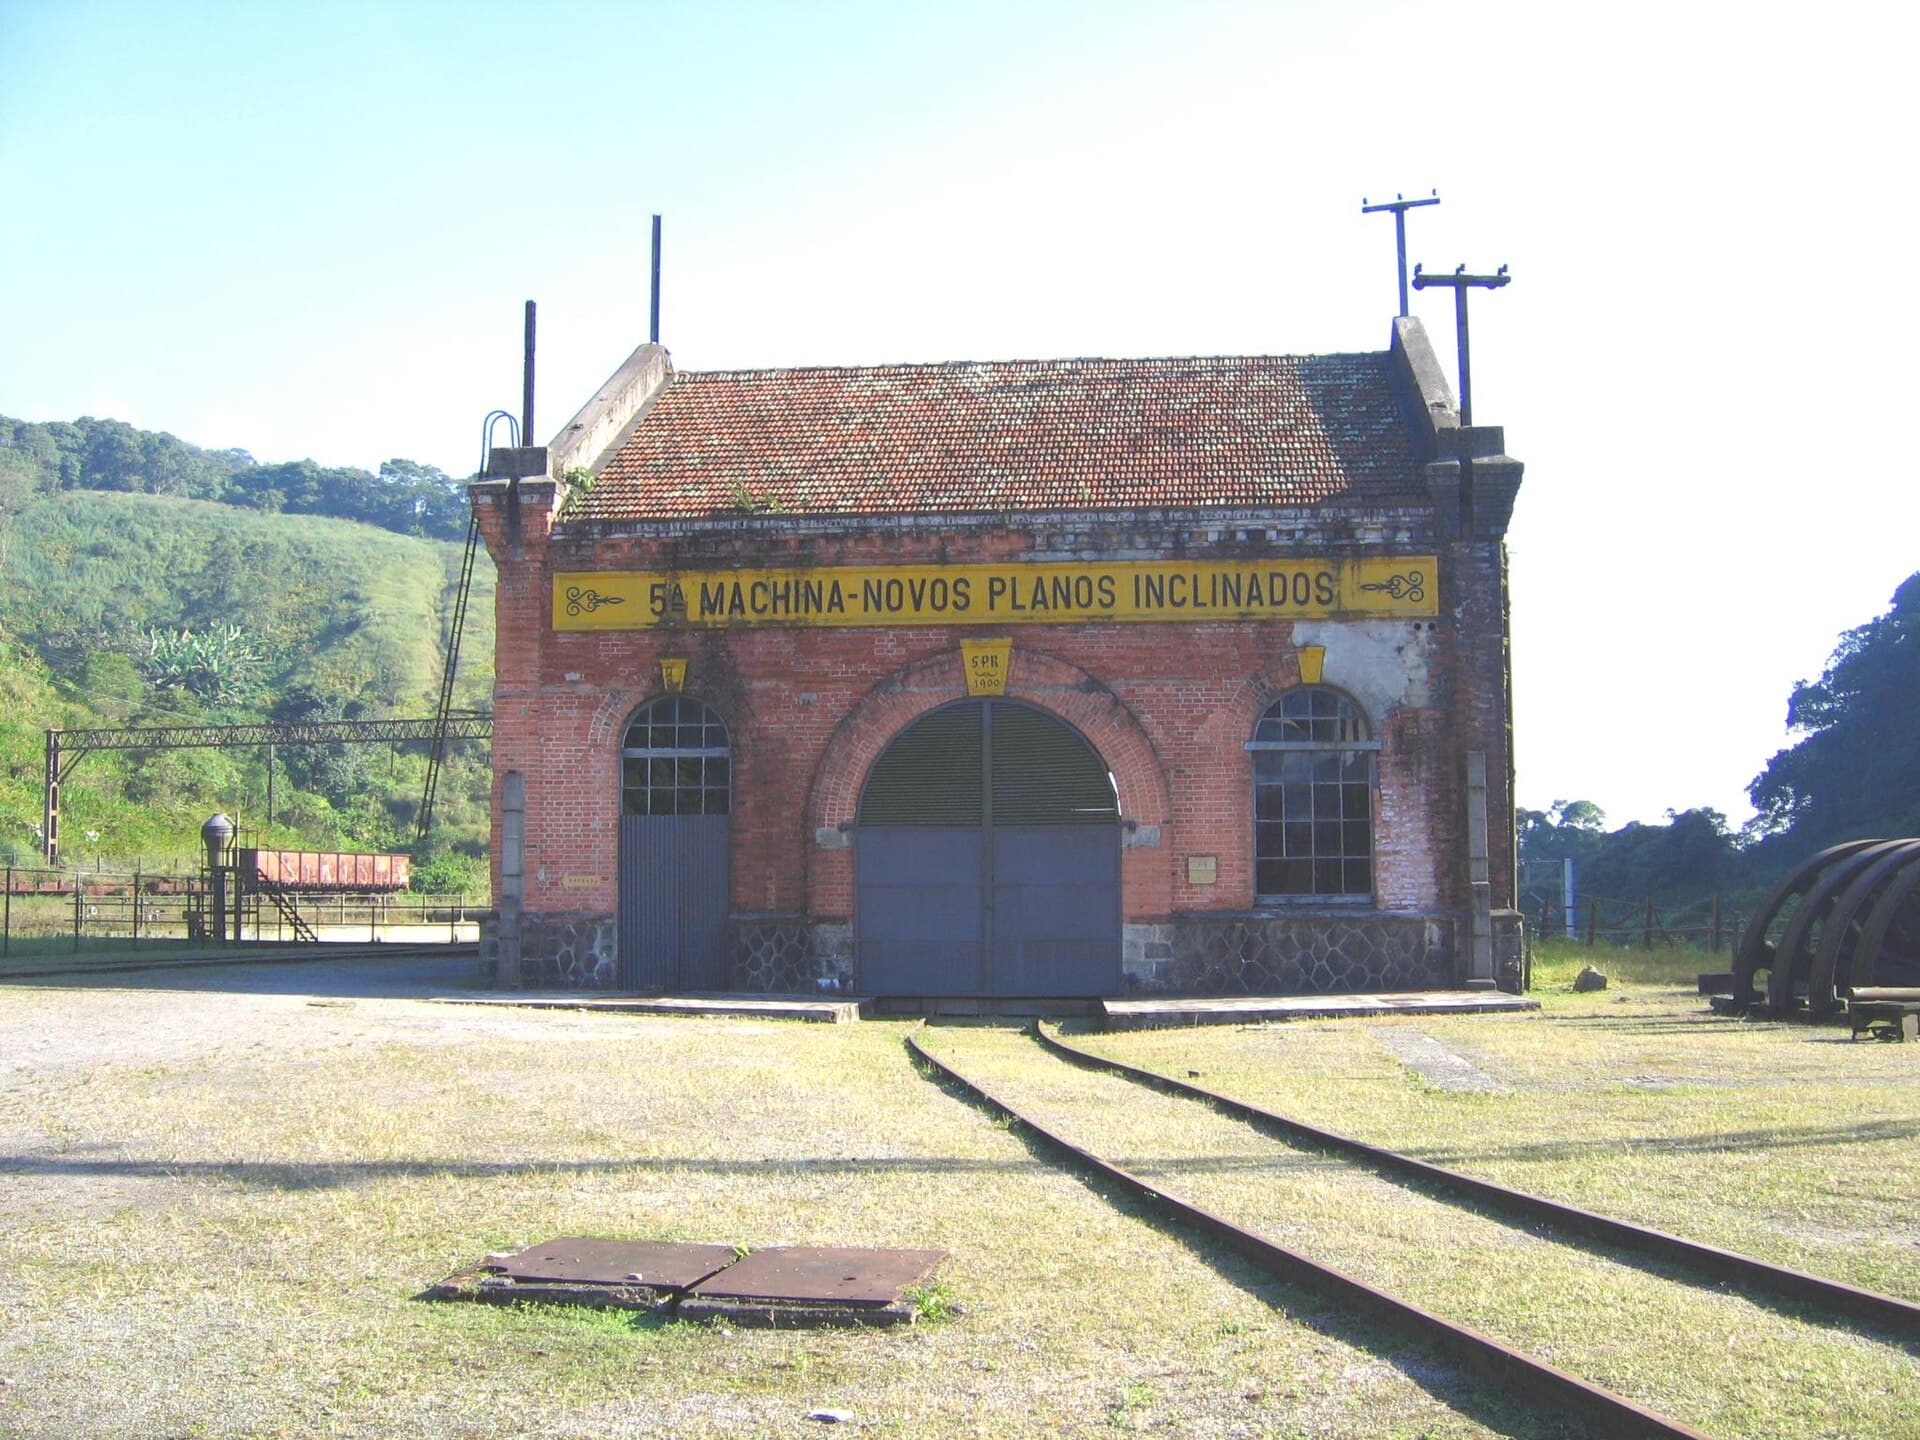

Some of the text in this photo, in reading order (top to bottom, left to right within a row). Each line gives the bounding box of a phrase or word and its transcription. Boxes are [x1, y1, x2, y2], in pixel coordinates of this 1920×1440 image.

[988, 574, 1116, 612] PLANOS
[1134, 571, 1334, 609] INCLINADOS
[971, 655, 999, 669] SPR
[974, 678, 1000, 689] 1900
